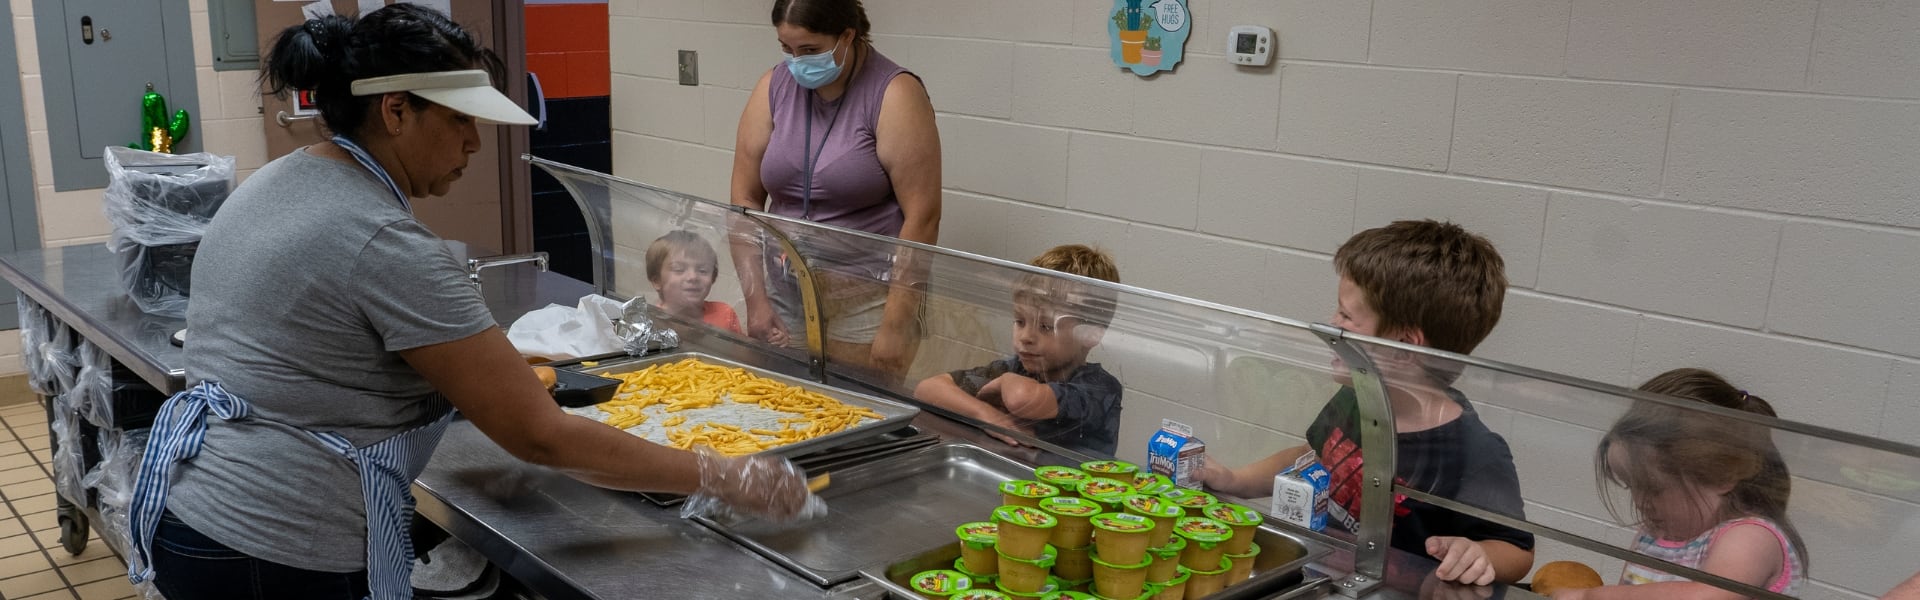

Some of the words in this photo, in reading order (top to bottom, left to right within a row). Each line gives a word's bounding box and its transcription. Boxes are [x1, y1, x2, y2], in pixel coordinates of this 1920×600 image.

[1163, 4, 1179, 13] FREE
[1161, 14, 1179, 24] HUGS
[1149, 452, 1176, 472] TruMoo
